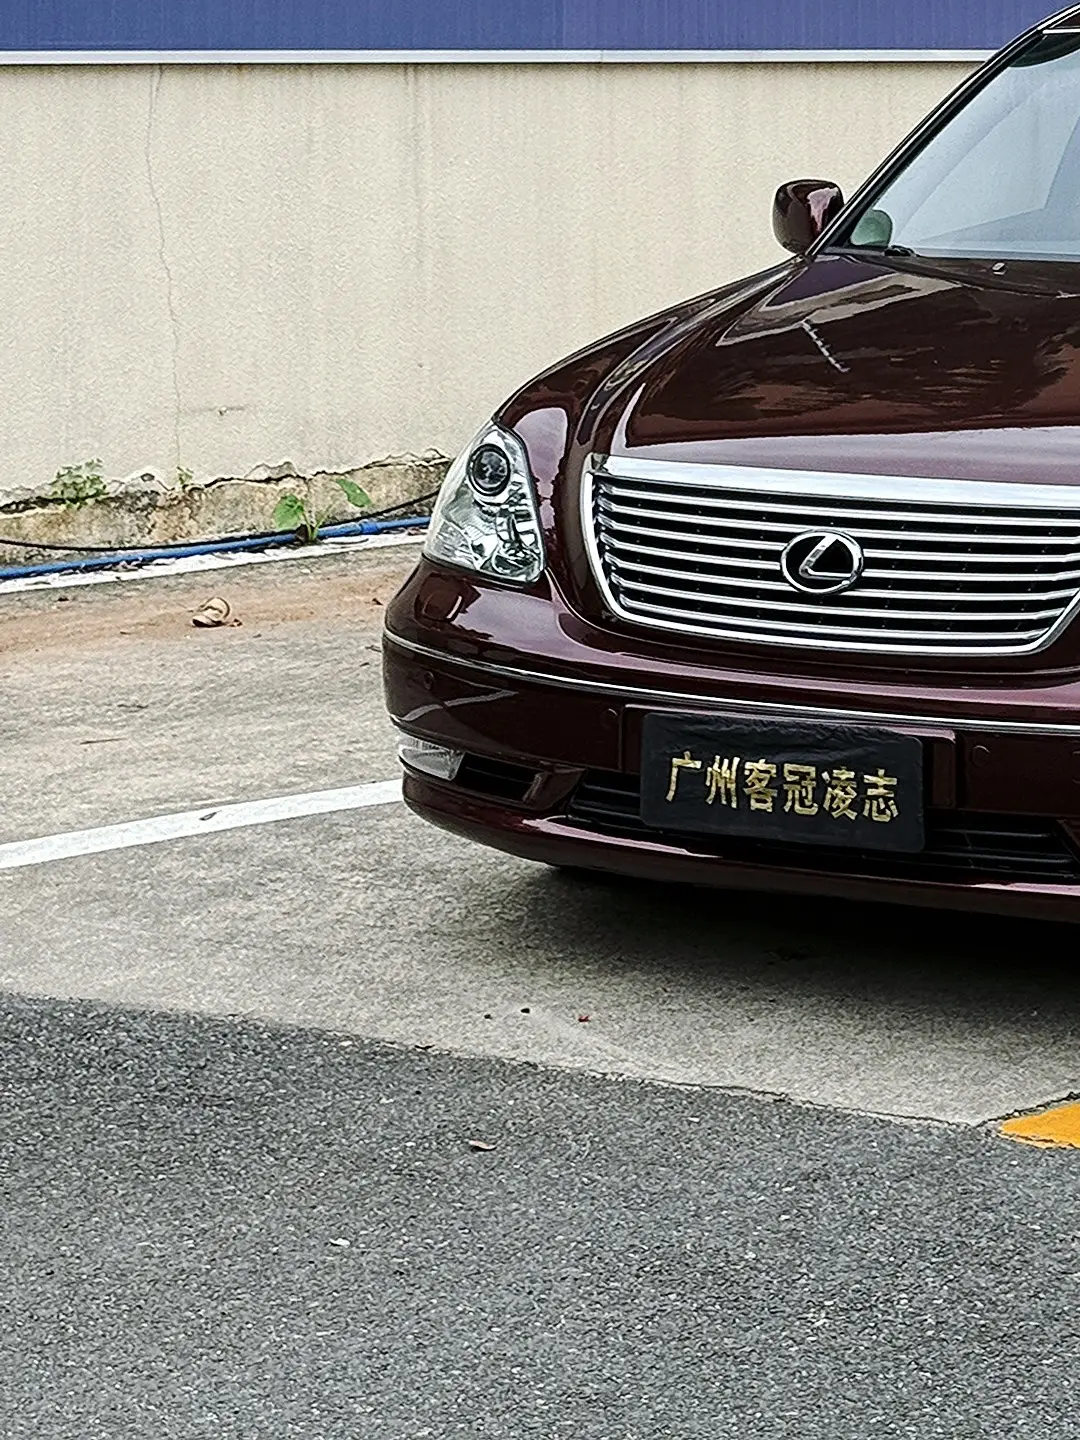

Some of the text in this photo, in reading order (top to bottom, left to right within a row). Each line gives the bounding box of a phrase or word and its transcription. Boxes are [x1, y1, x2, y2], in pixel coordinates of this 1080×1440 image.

[666, 750, 899, 822] 广州客冠凌志
